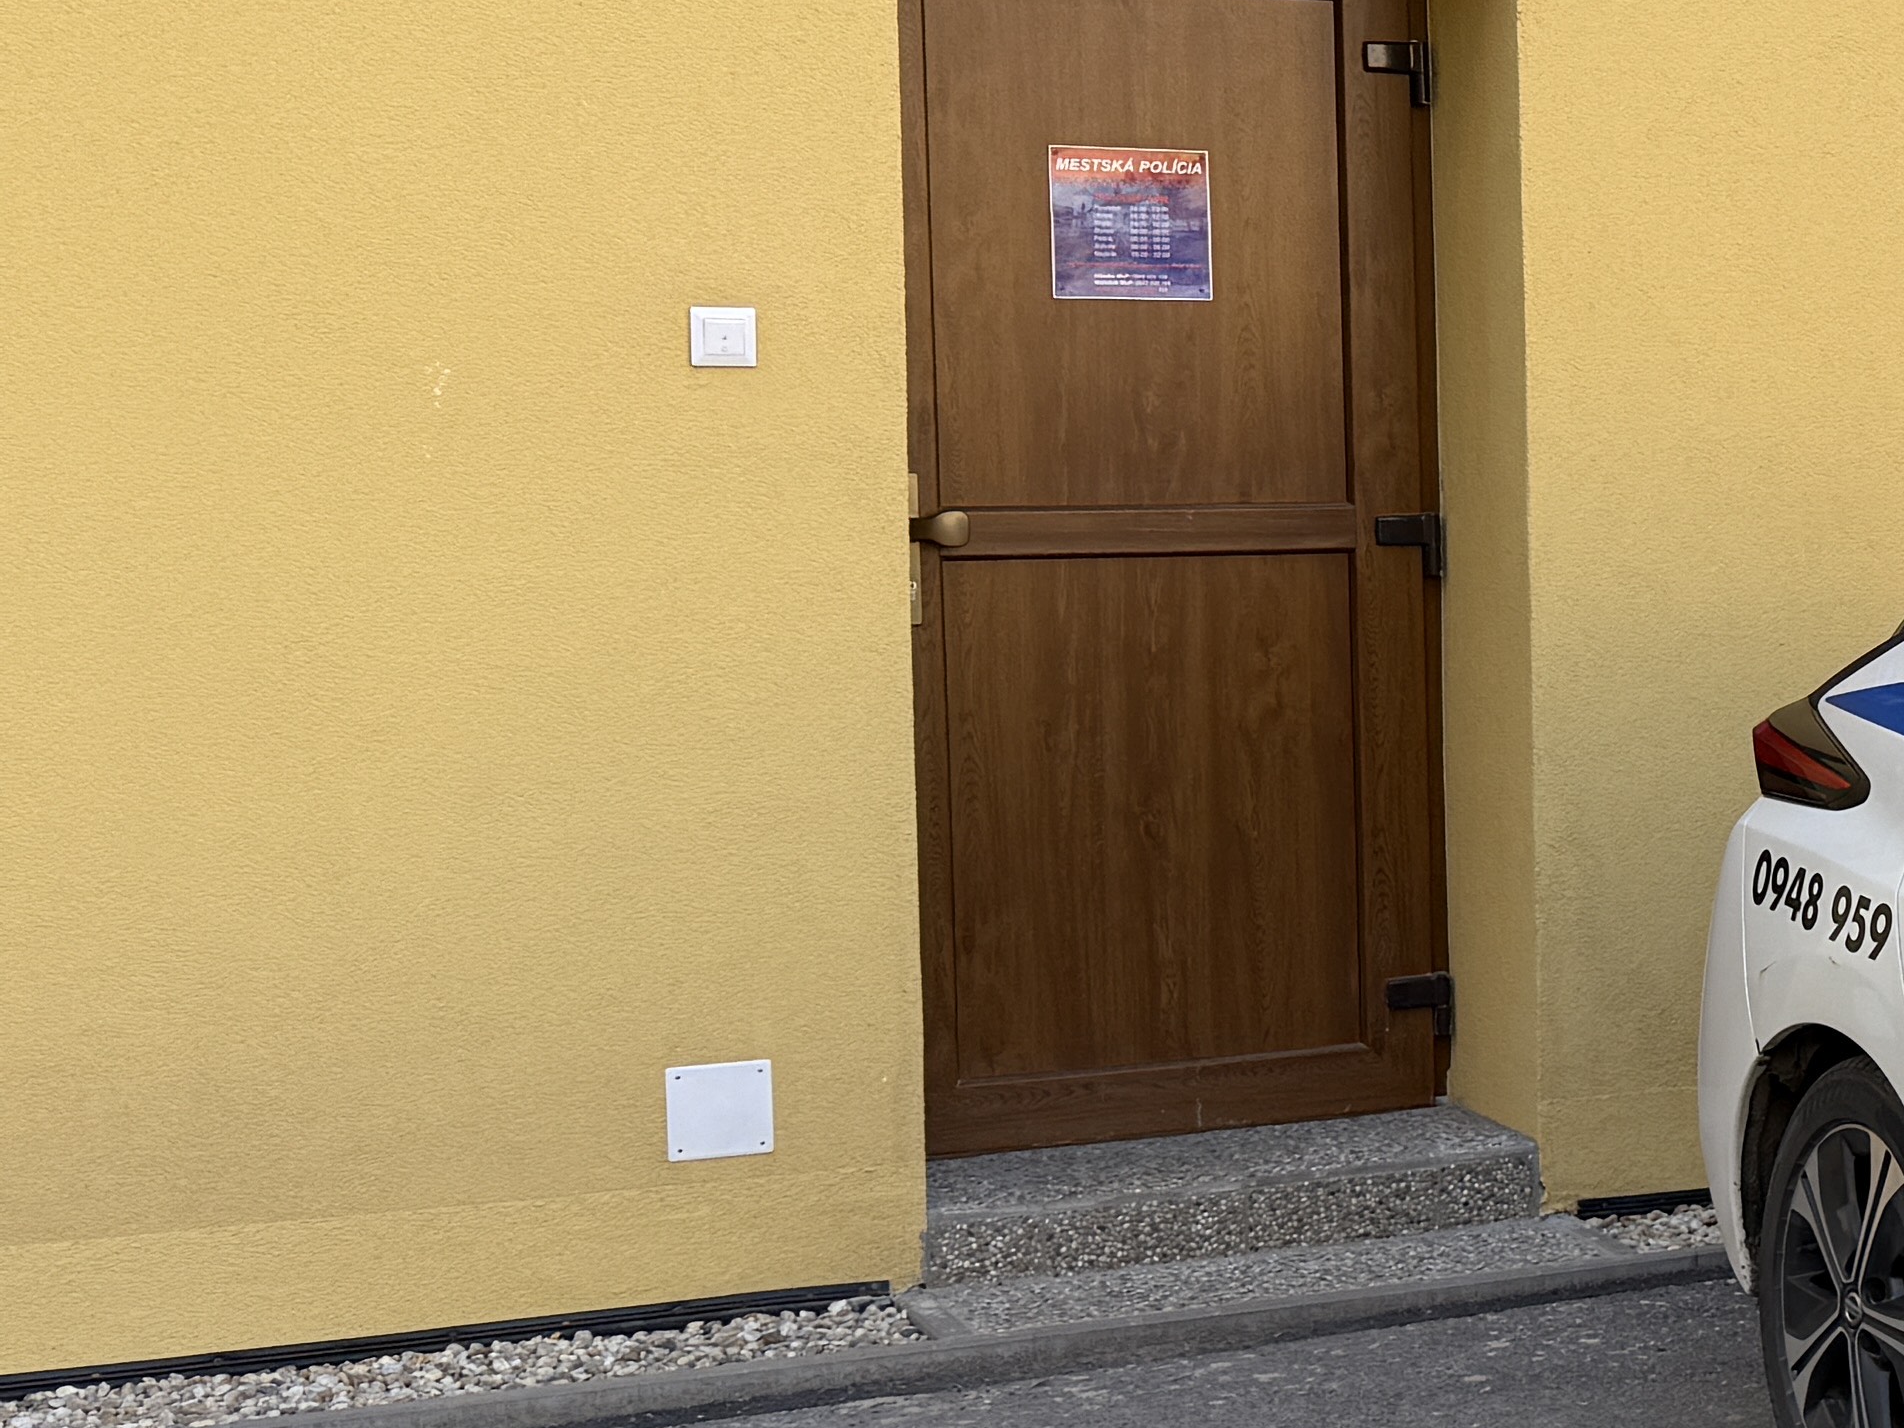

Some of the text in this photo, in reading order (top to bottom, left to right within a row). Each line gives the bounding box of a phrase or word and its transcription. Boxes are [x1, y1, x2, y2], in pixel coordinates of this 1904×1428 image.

[1055, 157, 1202, 175] MESTSKÁ POLÍCIA
[1751, 849, 1824, 930] 0948
[1828, 884, 1893, 962] 959
